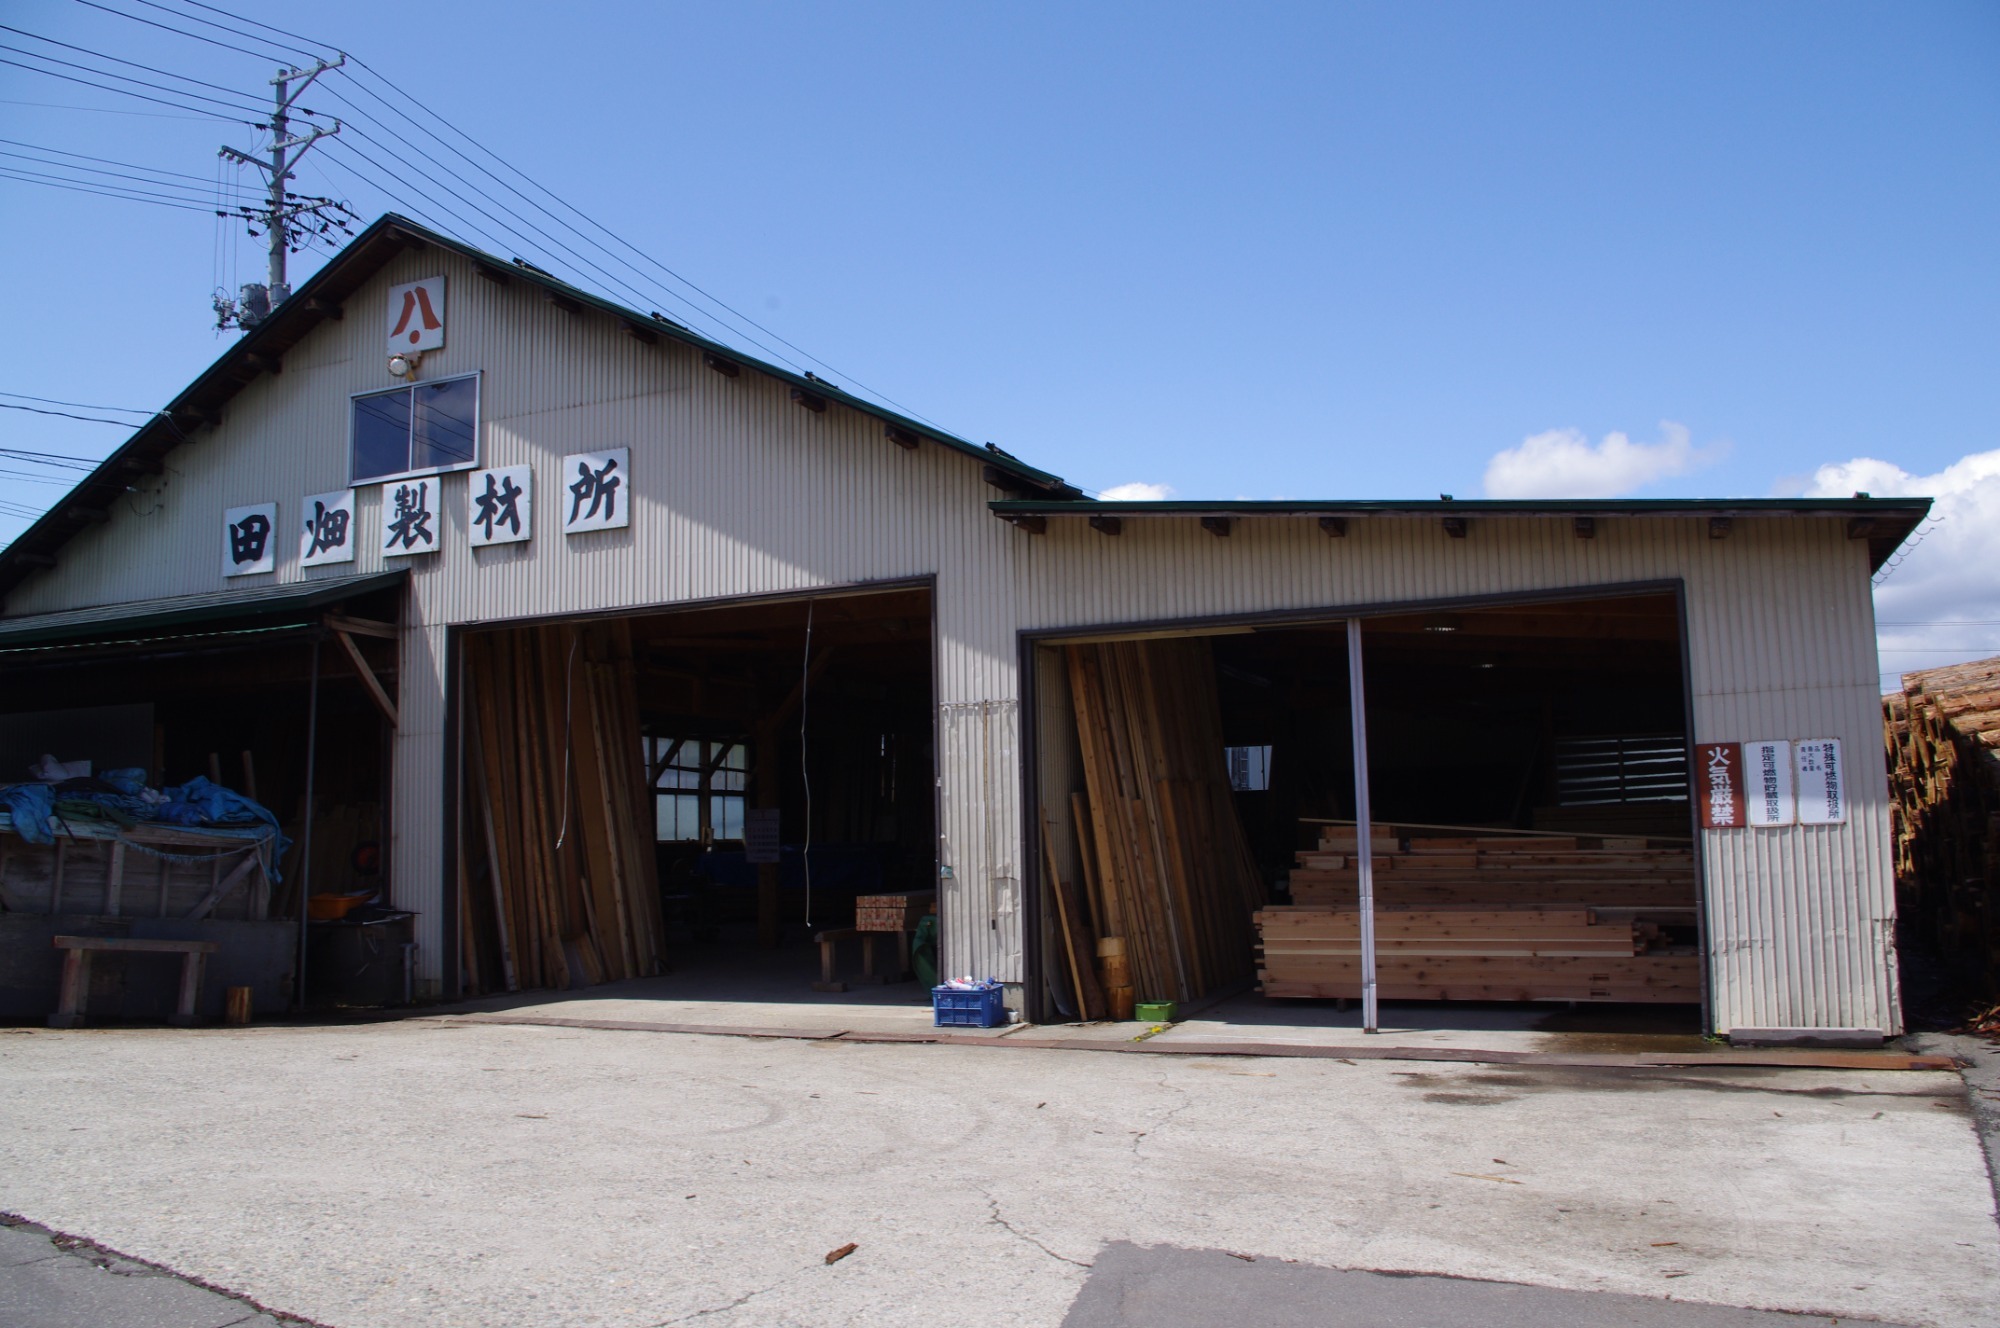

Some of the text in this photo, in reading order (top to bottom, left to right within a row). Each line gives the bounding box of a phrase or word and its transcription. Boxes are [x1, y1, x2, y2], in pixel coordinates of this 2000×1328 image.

[229, 459, 621, 565] 田畑製材所
[1708, 746, 1734, 825] 火気厳禁
[1761, 745, 1780, 822] 指定可燃物貯蔵取扱所
